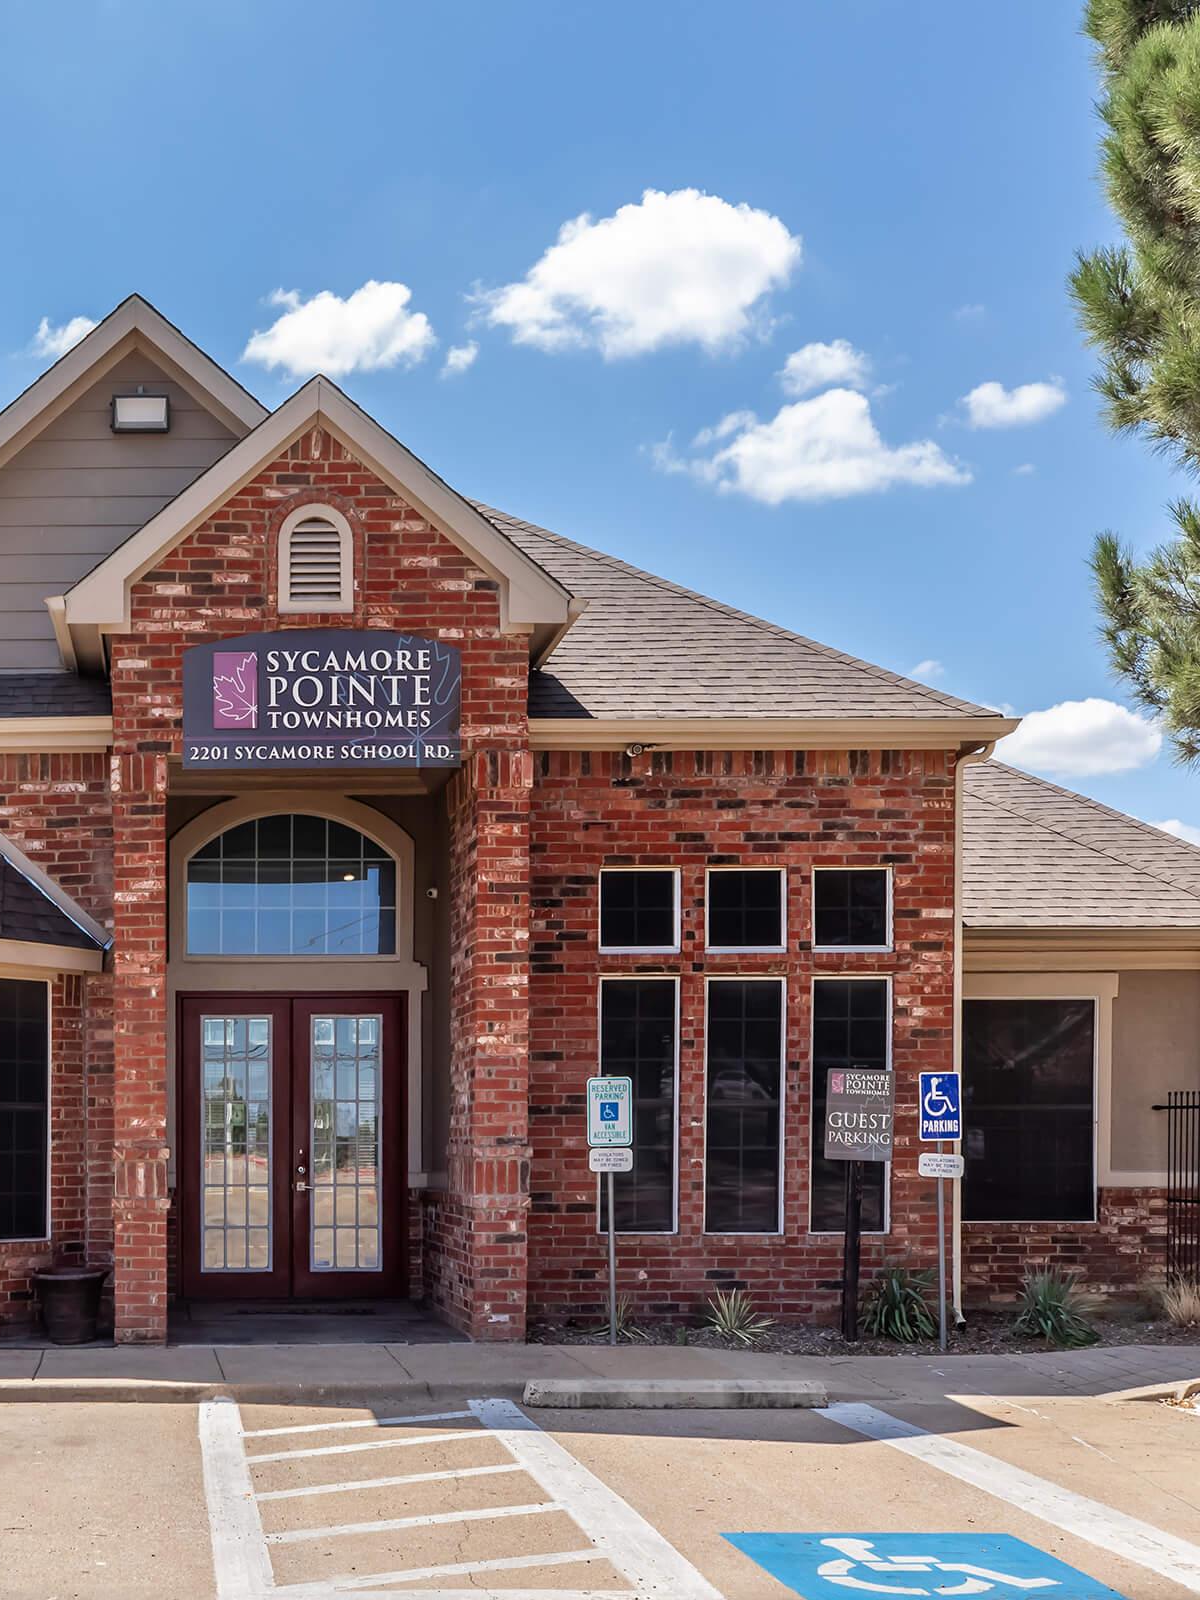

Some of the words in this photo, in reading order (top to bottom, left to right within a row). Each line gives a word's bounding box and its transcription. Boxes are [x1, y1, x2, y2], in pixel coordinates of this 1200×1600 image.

[267, 650, 431, 672] SYCAMORE
[268, 674, 432, 708] POINTE
[268, 710, 431, 728] TOWNHOMES
[190, 746, 228, 760] 2201
[235, 746, 334, 760] SYCAMORE
[341, 745, 418, 759] SCHOOL
[424, 746, 454, 759] RD.
[592, 1084, 627, 1092] RESERVED
[846, 1080, 889, 1090] POINTE
[829, 1112, 890, 1129] GUEST
[923, 1120, 958, 1132] PARKING
[594, 1130, 626, 1139] ACCESSIBLE
[829, 1131, 890, 1144] PARKING
